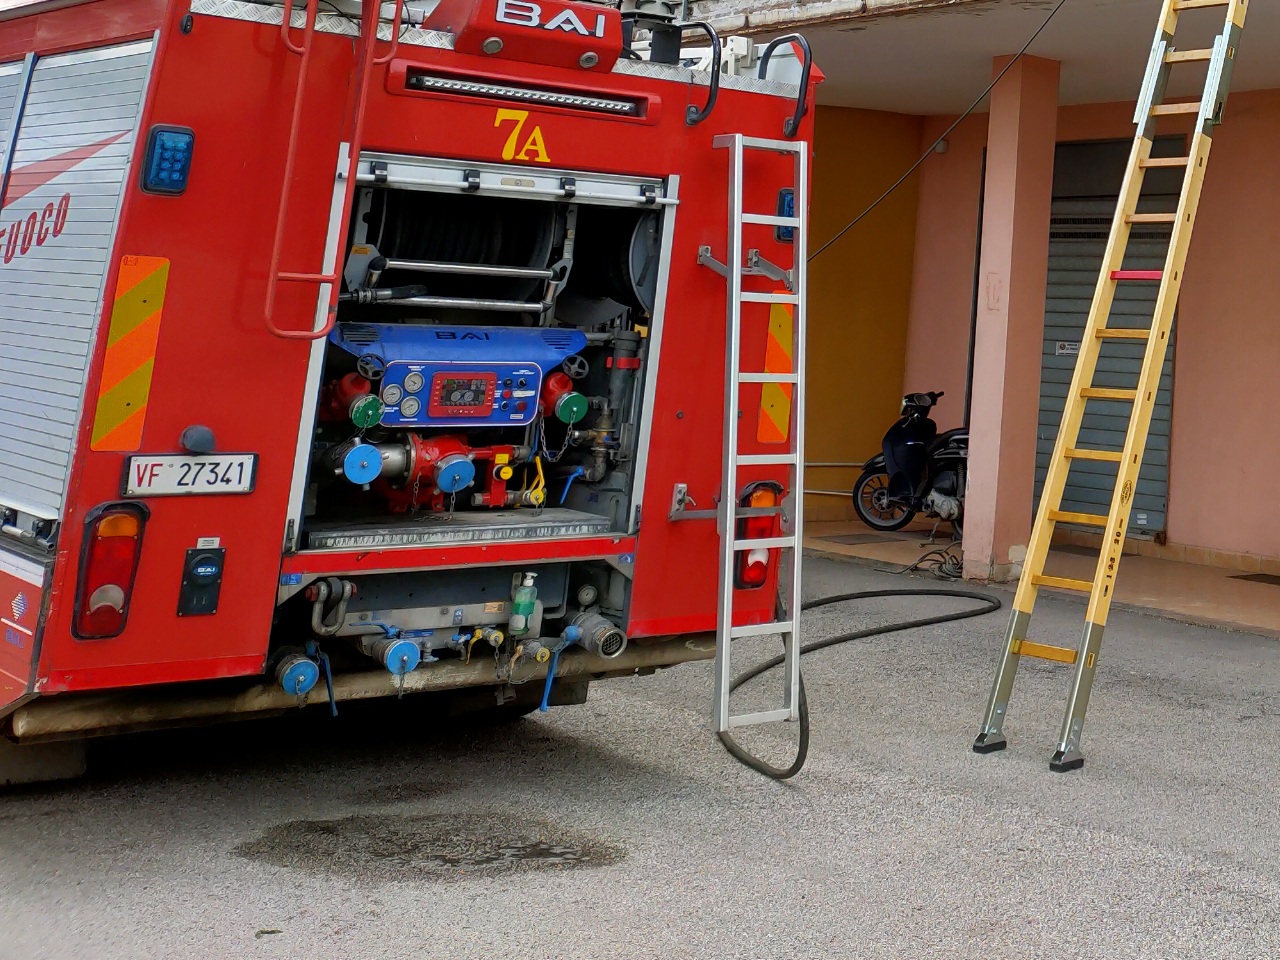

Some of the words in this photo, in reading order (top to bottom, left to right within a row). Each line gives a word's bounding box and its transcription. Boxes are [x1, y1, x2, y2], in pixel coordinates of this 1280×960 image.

[494, 109, 551, 163] 7A
[435, 331, 490, 341] BAI
[136, 463, 163, 487] VF
[177, 461, 244, 486] 27341
